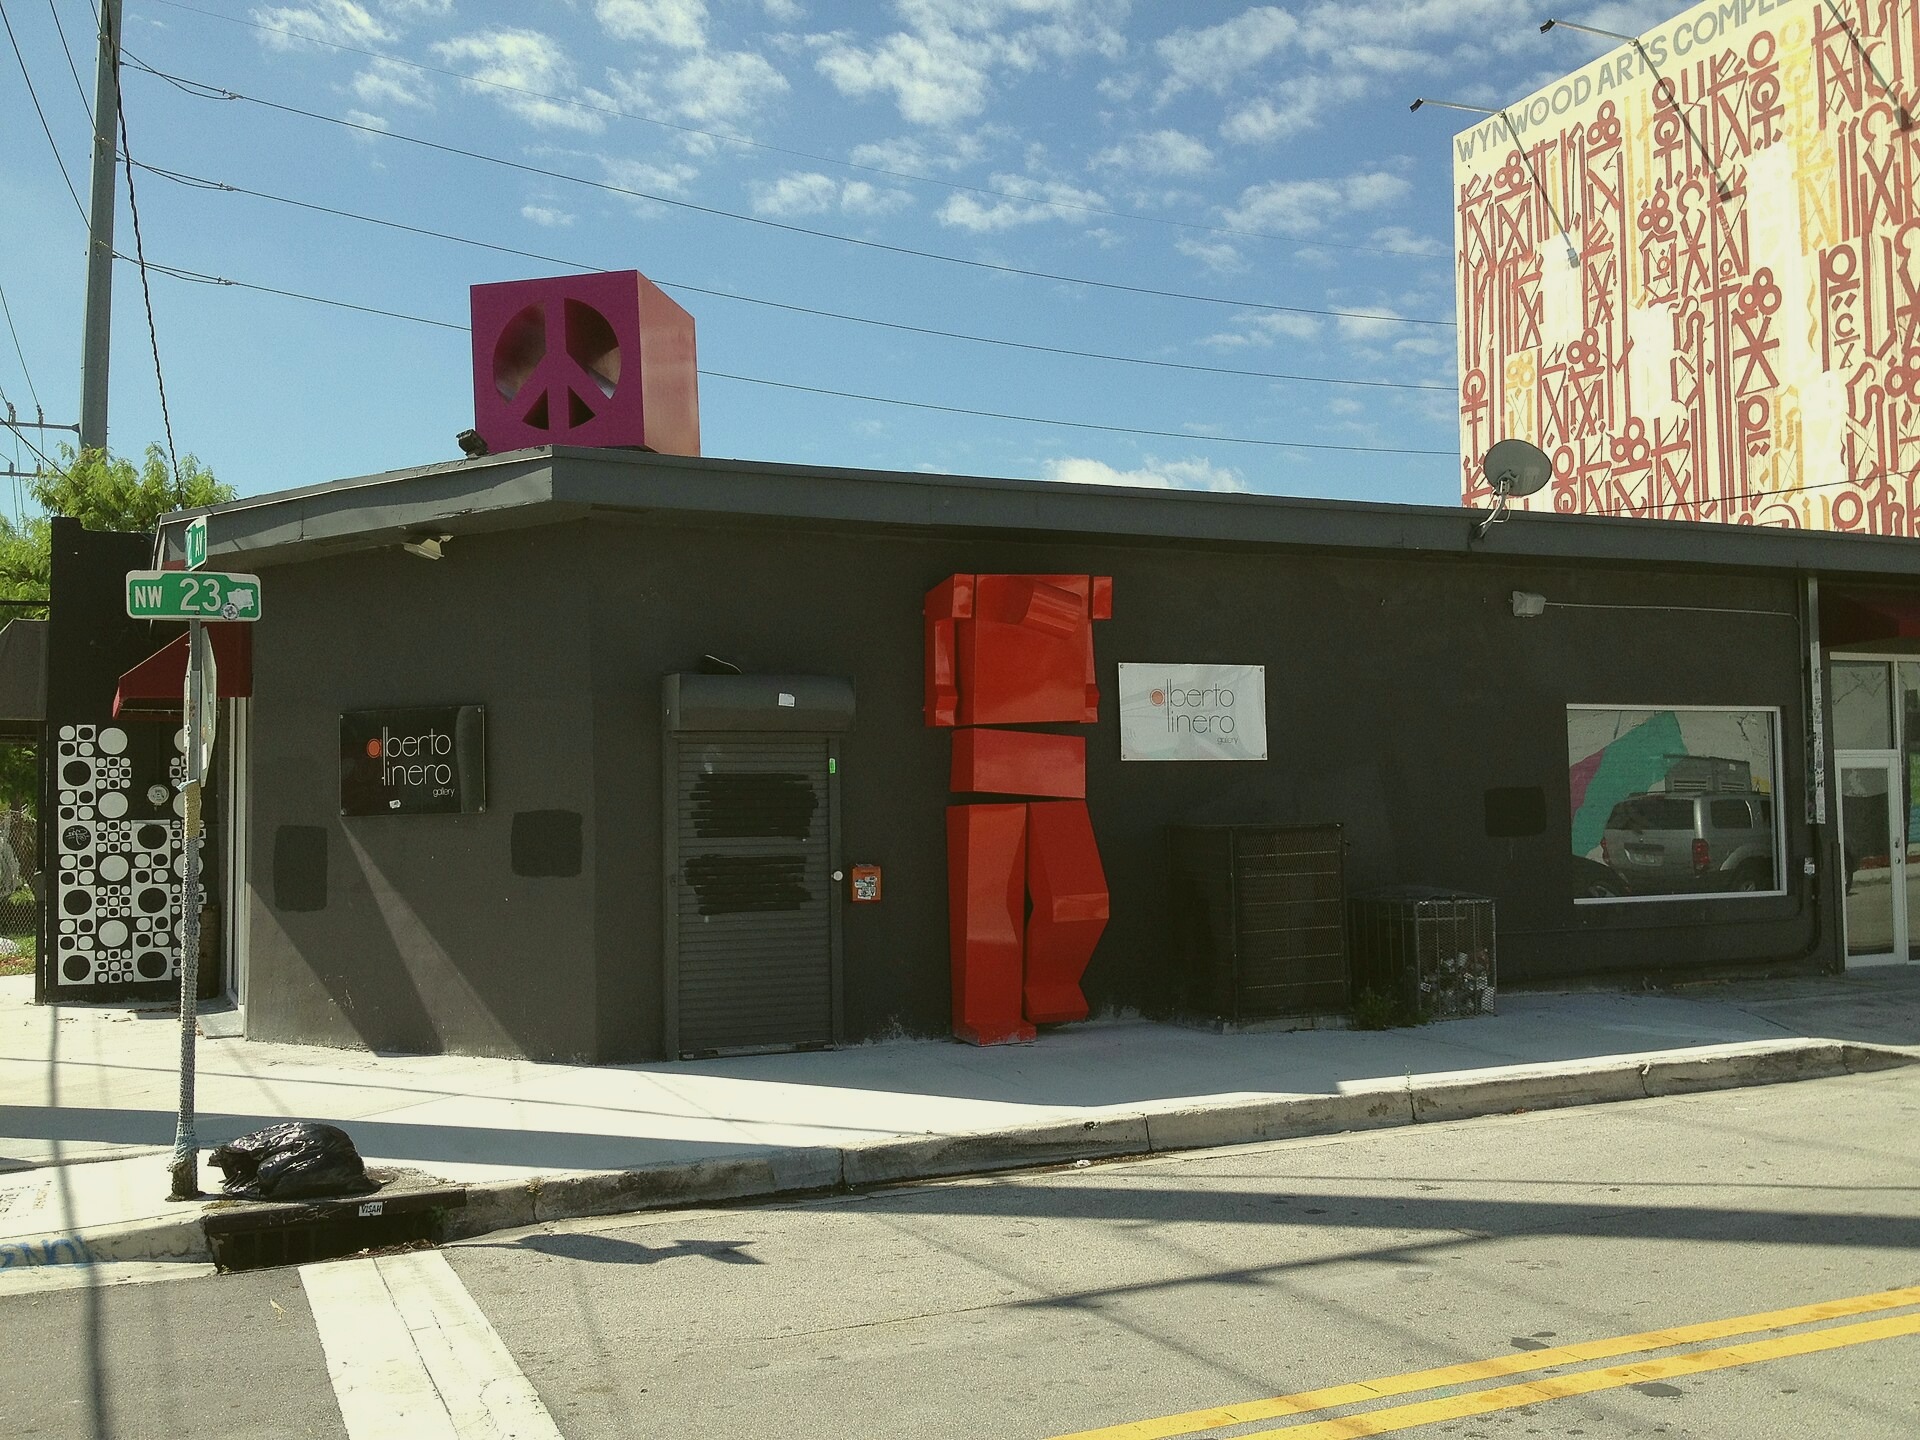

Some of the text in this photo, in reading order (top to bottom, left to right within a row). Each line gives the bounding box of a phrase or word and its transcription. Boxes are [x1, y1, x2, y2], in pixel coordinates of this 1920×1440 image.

[1456, 0, 1793, 163] WYNWOOD ARTS COMPL
[134, 577, 222, 612] NW 23
[1150, 678, 1235, 708] alberto
[1167, 710, 1235, 734] linero
[366, 726, 452, 759] alberto
[382, 760, 452, 786] linero
